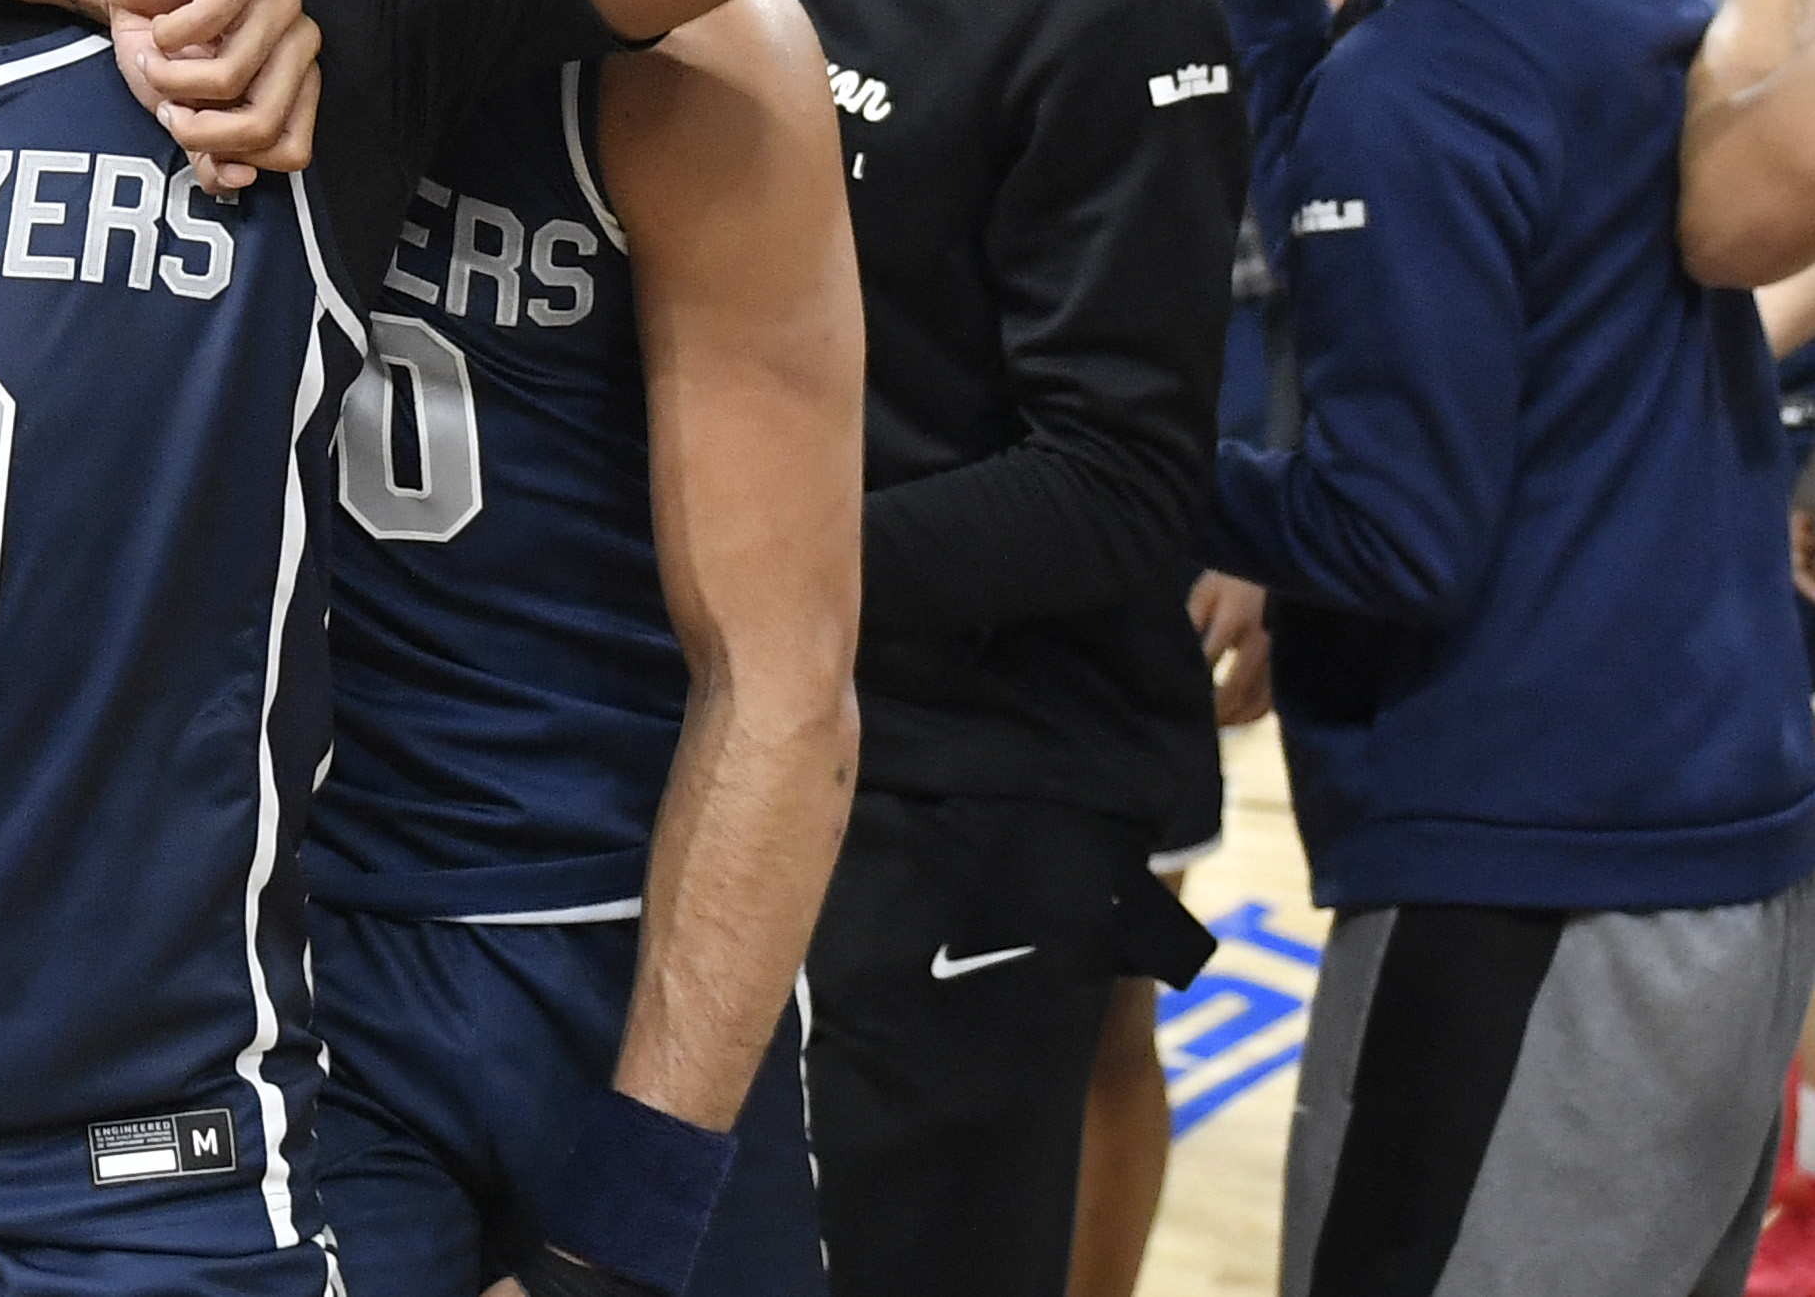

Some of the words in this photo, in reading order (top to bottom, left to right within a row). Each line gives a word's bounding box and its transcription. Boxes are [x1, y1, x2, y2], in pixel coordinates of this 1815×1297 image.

[825, 60, 892, 122] on
[94, 1121, 171, 1137] ENGINEERED
[192, 1127, 219, 1157] M
